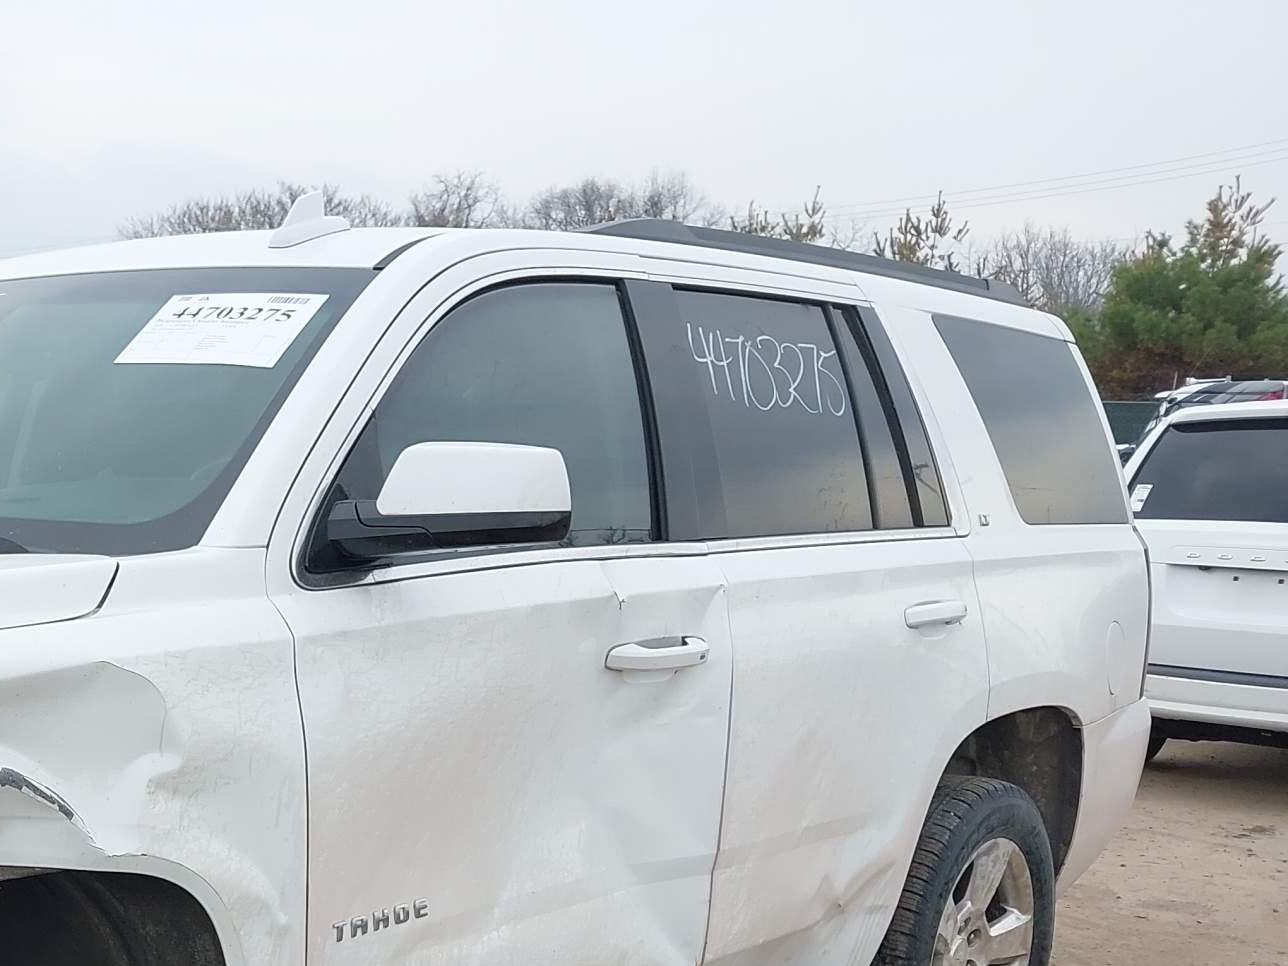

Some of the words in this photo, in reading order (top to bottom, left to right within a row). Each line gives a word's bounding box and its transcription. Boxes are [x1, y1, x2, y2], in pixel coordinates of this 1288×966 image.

[172, 306, 296, 322] 44703275
[686, 322, 846, 416] 44703275
[332, 897, 430, 943] TAHOE
